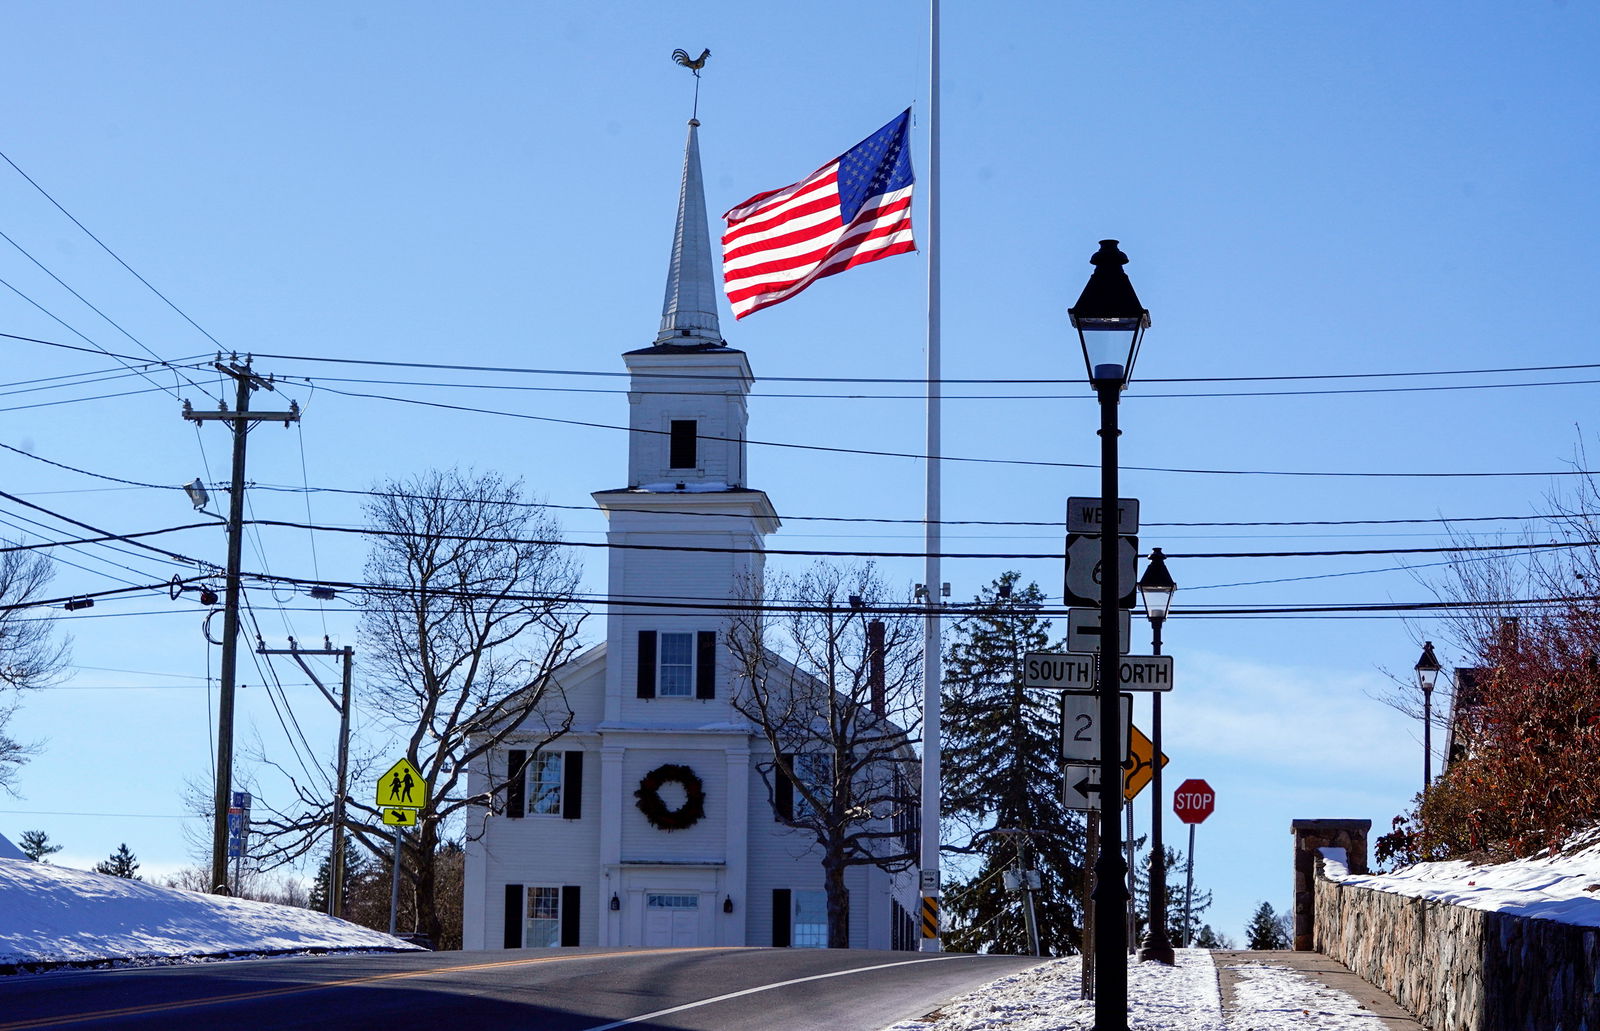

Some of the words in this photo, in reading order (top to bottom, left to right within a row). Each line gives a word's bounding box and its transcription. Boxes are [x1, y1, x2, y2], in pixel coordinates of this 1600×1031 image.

[1082, 507, 1125, 524] WET
[1029, 660, 1088, 682] SOUTH
[1119, 663, 1167, 683] ORTH
[1074, 713, 1093, 741] 2
[1176, 793, 1212, 810] STOP
